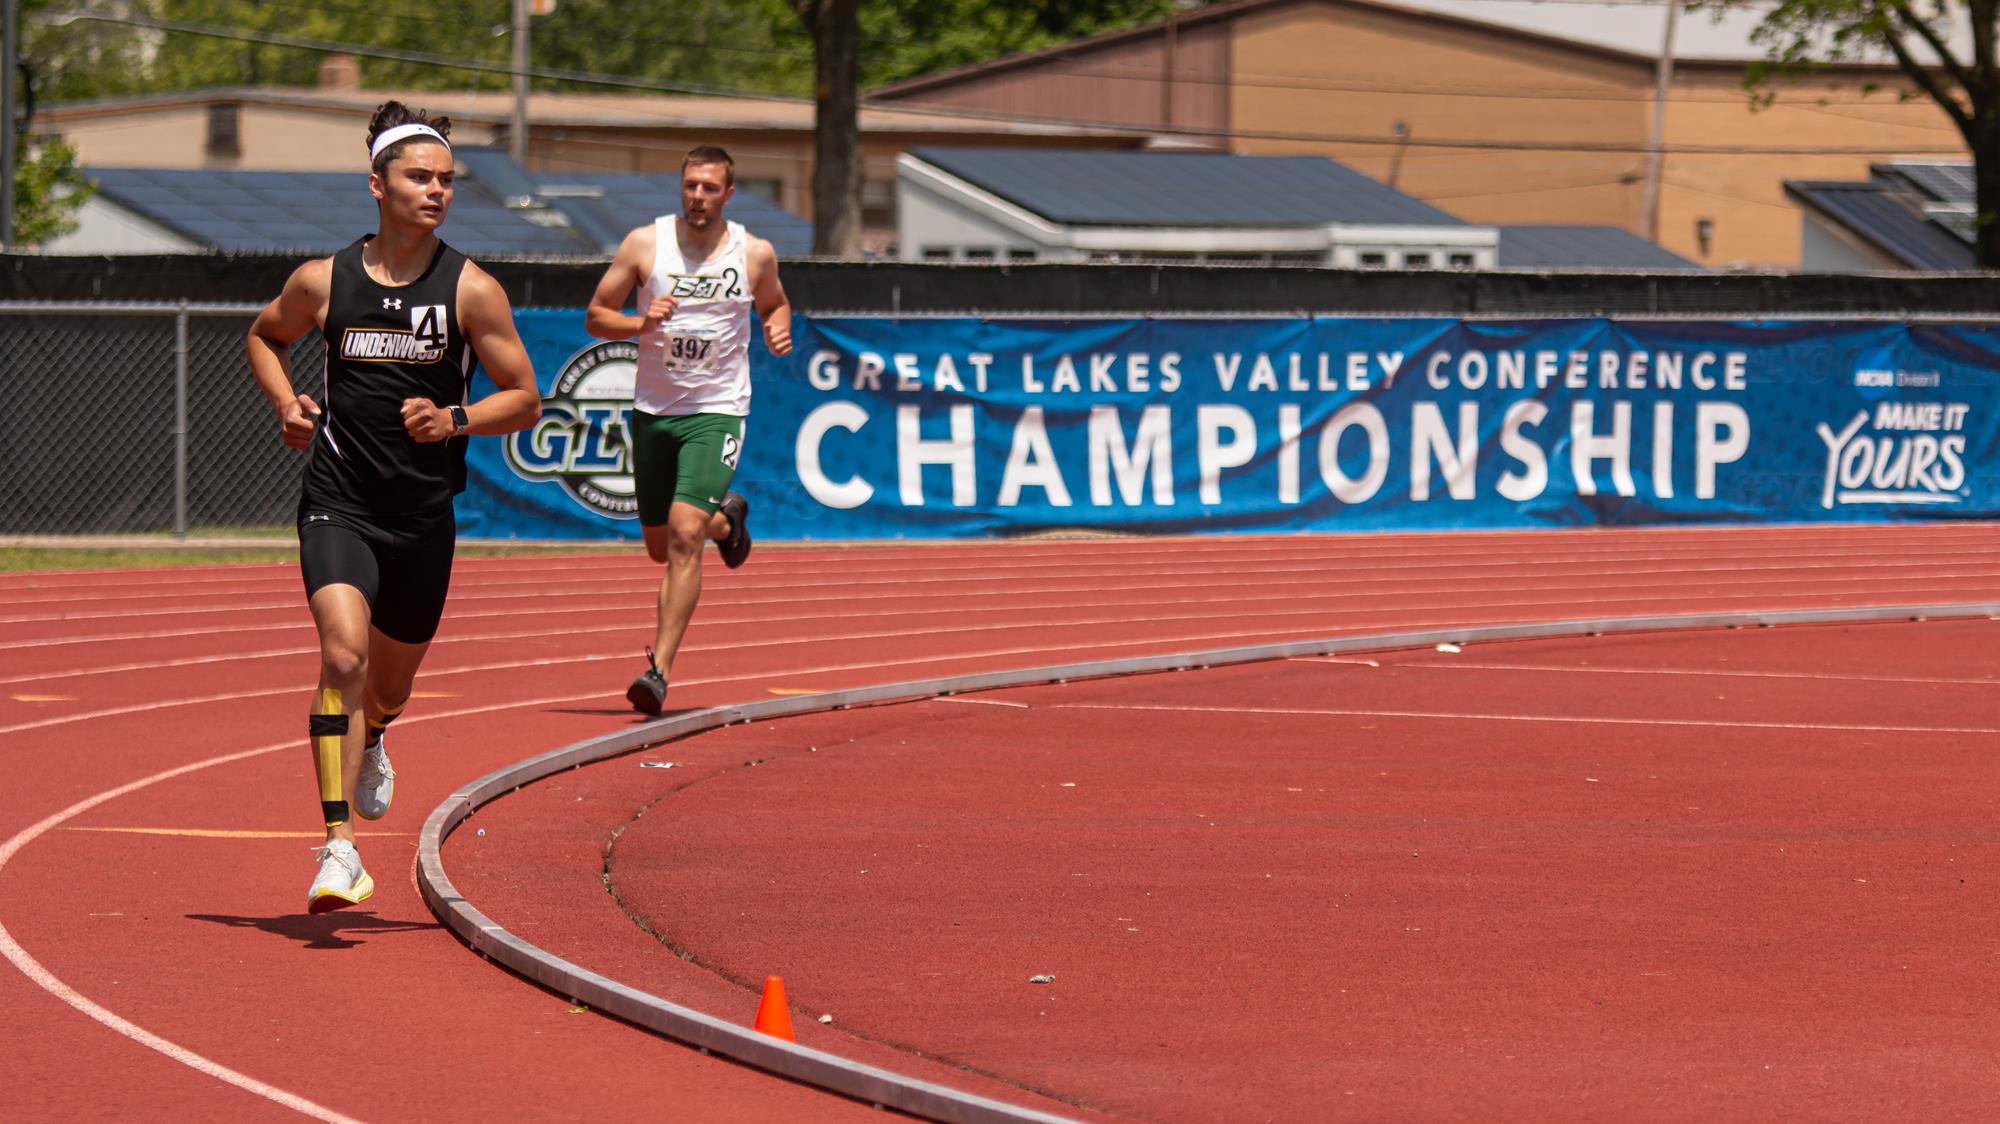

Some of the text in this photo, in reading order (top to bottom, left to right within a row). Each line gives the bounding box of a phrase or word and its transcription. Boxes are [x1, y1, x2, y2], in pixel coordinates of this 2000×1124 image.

[722, 268, 741, 299] 2
[415, 306, 446, 351] 4
[344, 332, 439, 360] LINDENWO
[671, 337, 712, 360] 397
[808, 350, 993, 392] GREAT
[1022, 352, 1182, 393] LAKES
[1214, 351, 1404, 393] VALLEY
[1426, 350, 1747, 391] CONFERENCE
[1872, 402, 1970, 431] MAKE IT
[723, 437, 738, 467] 2
[795, 400, 1751, 509] CHAMPIONSHIP
